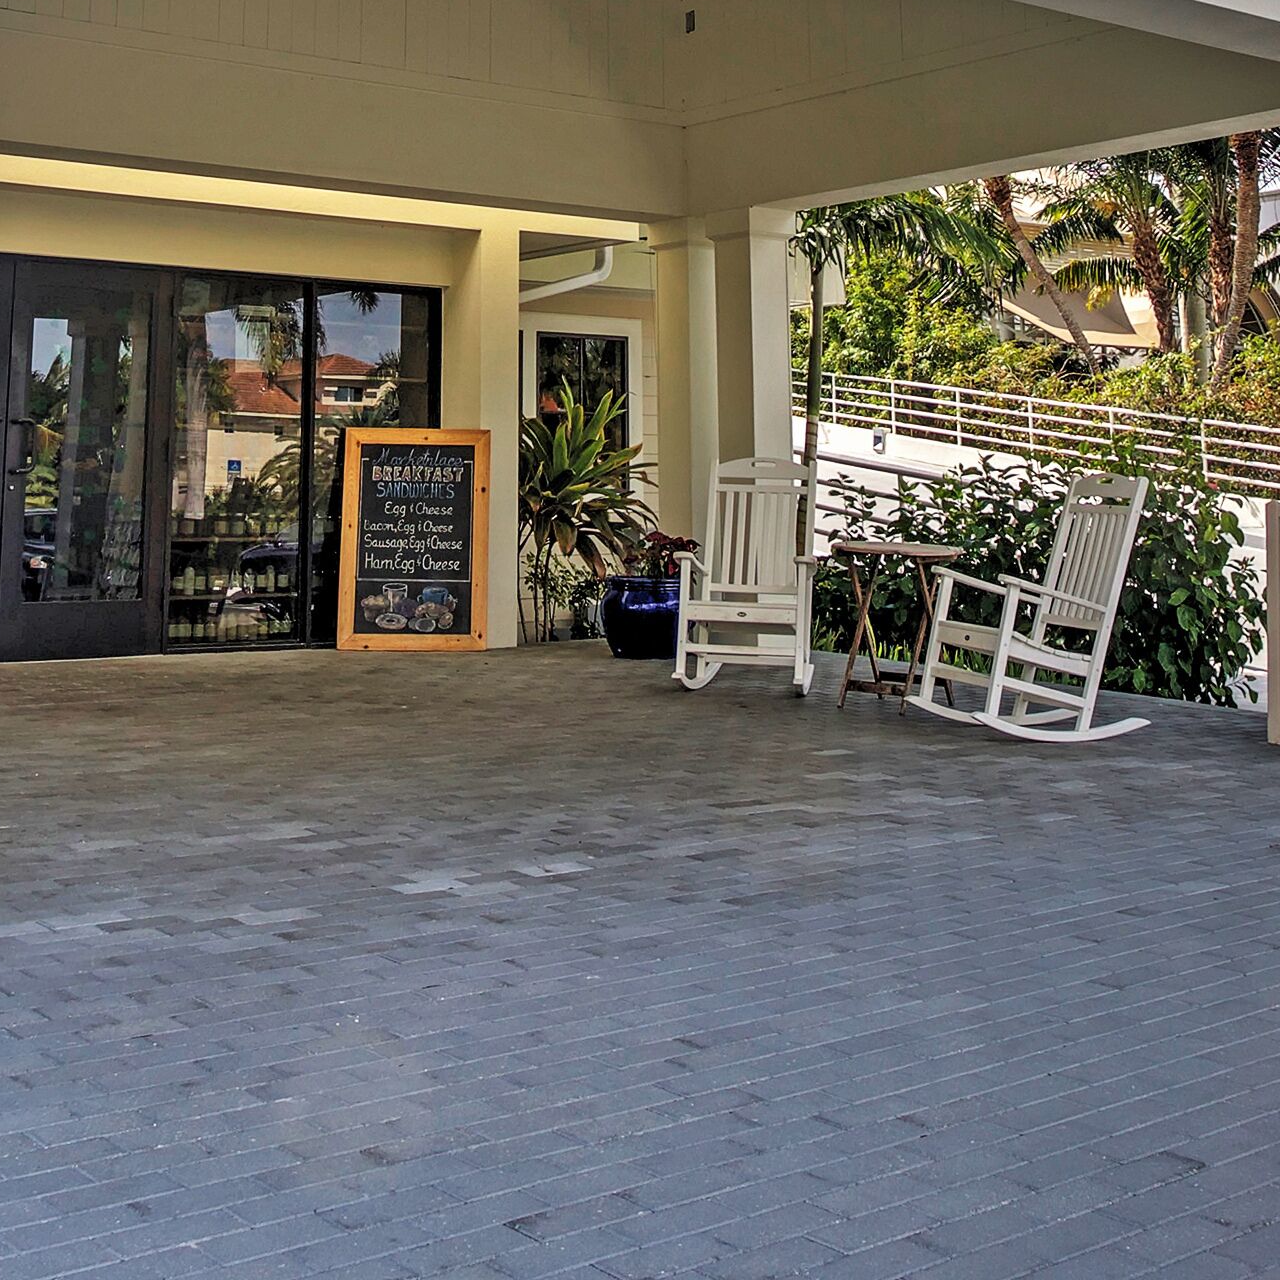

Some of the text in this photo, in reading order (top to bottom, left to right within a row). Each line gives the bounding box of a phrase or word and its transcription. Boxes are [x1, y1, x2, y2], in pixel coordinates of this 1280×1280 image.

[372, 465, 464, 482] BREAKFAST
[376, 482, 455, 498] SANDWICHES
[384, 501, 406, 517] Egg
[415, 502, 453, 515] Cheese
[397, 519, 415, 534] Egg
[423, 520, 453, 533] Cheese
[409, 536, 425, 552] Egg
[431, 535, 463, 550] Cheese
[395, 553, 415, 573] Egg
[422, 554, 460, 570] Cheese
